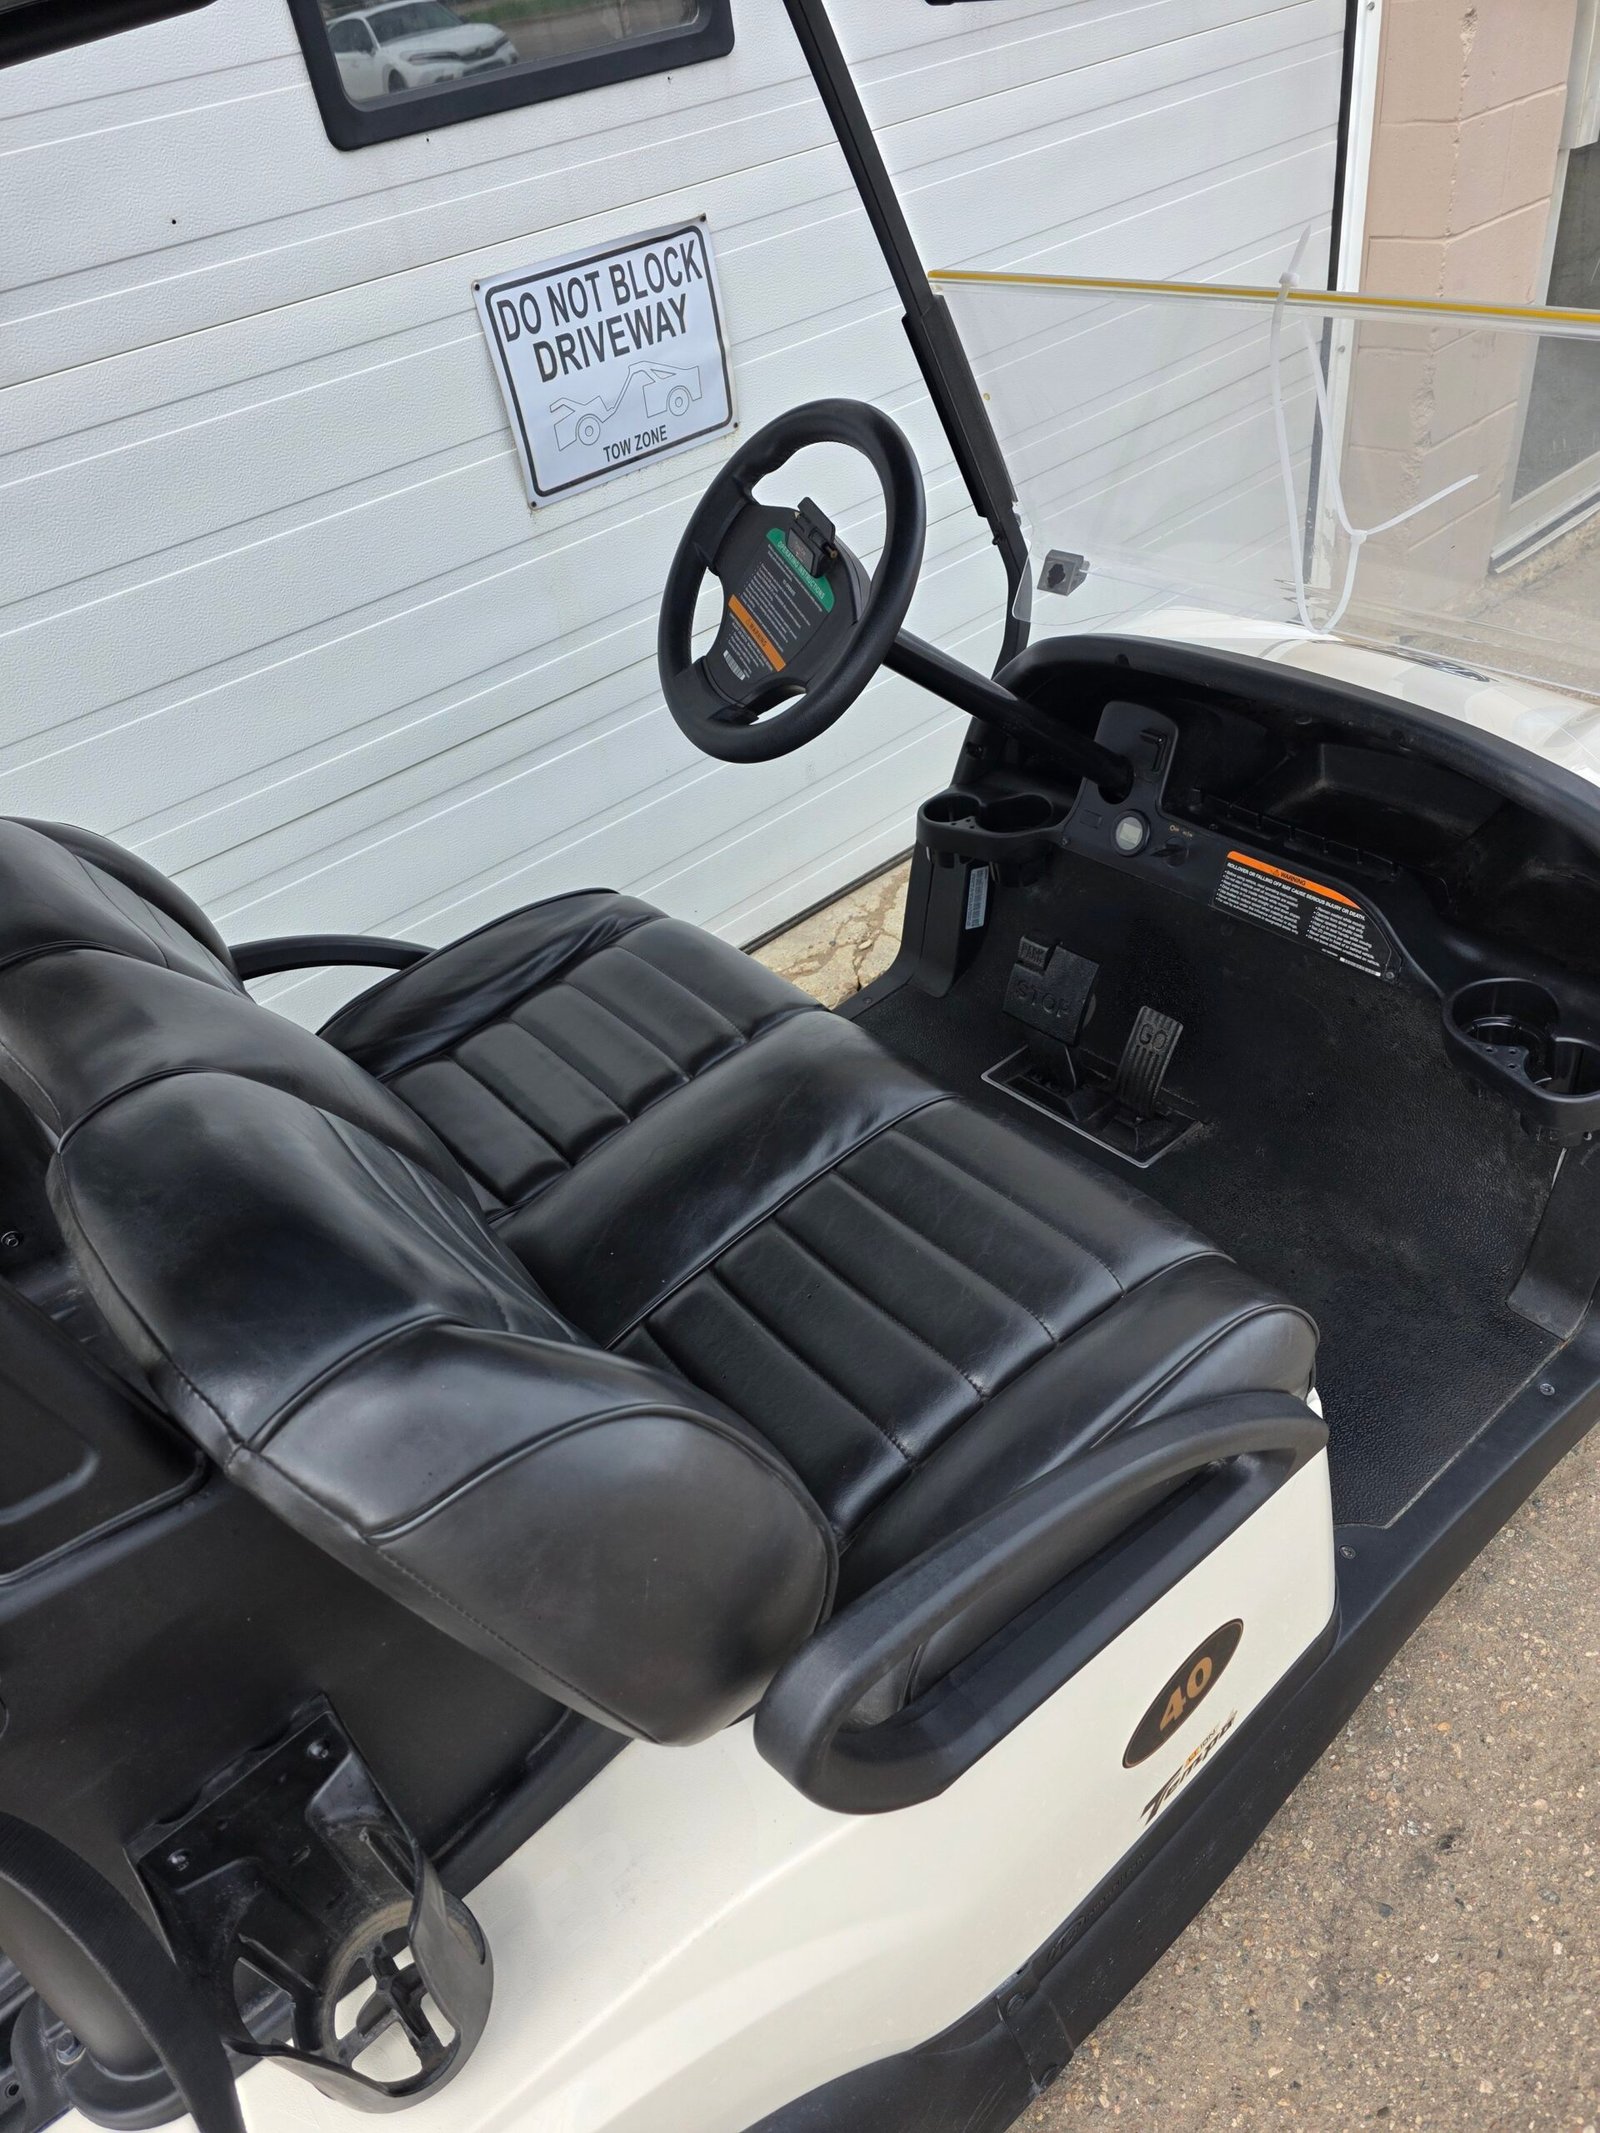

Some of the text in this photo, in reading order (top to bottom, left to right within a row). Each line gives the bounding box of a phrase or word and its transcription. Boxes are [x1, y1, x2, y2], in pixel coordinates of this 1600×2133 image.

[497, 240, 702, 342] DO NOT BLOCK
[533, 293, 686, 382] DRIVEWAY
[603, 425, 667, 462] TOW ZONE
[777, 541, 800, 569] OPERATING
[798, 565, 825, 600] INSTRUCTIONS
[749, 622, 767, 647] WARNING
[1226, 862, 1249, 874] ROLLOVER
[1255, 874, 1273, 883] FALLING
[1290, 888, 1305, 896] CAUSE
[1305, 893, 1325, 904] SERIOUS
[1280, 872, 1306, 885] WARNING
[1016, 980, 1071, 1017] STOP
[1139, 1023, 1167, 1049] GO
[1160, 1656, 1212, 1732] 40
[1139, 1710, 1237, 1826] Tempo
